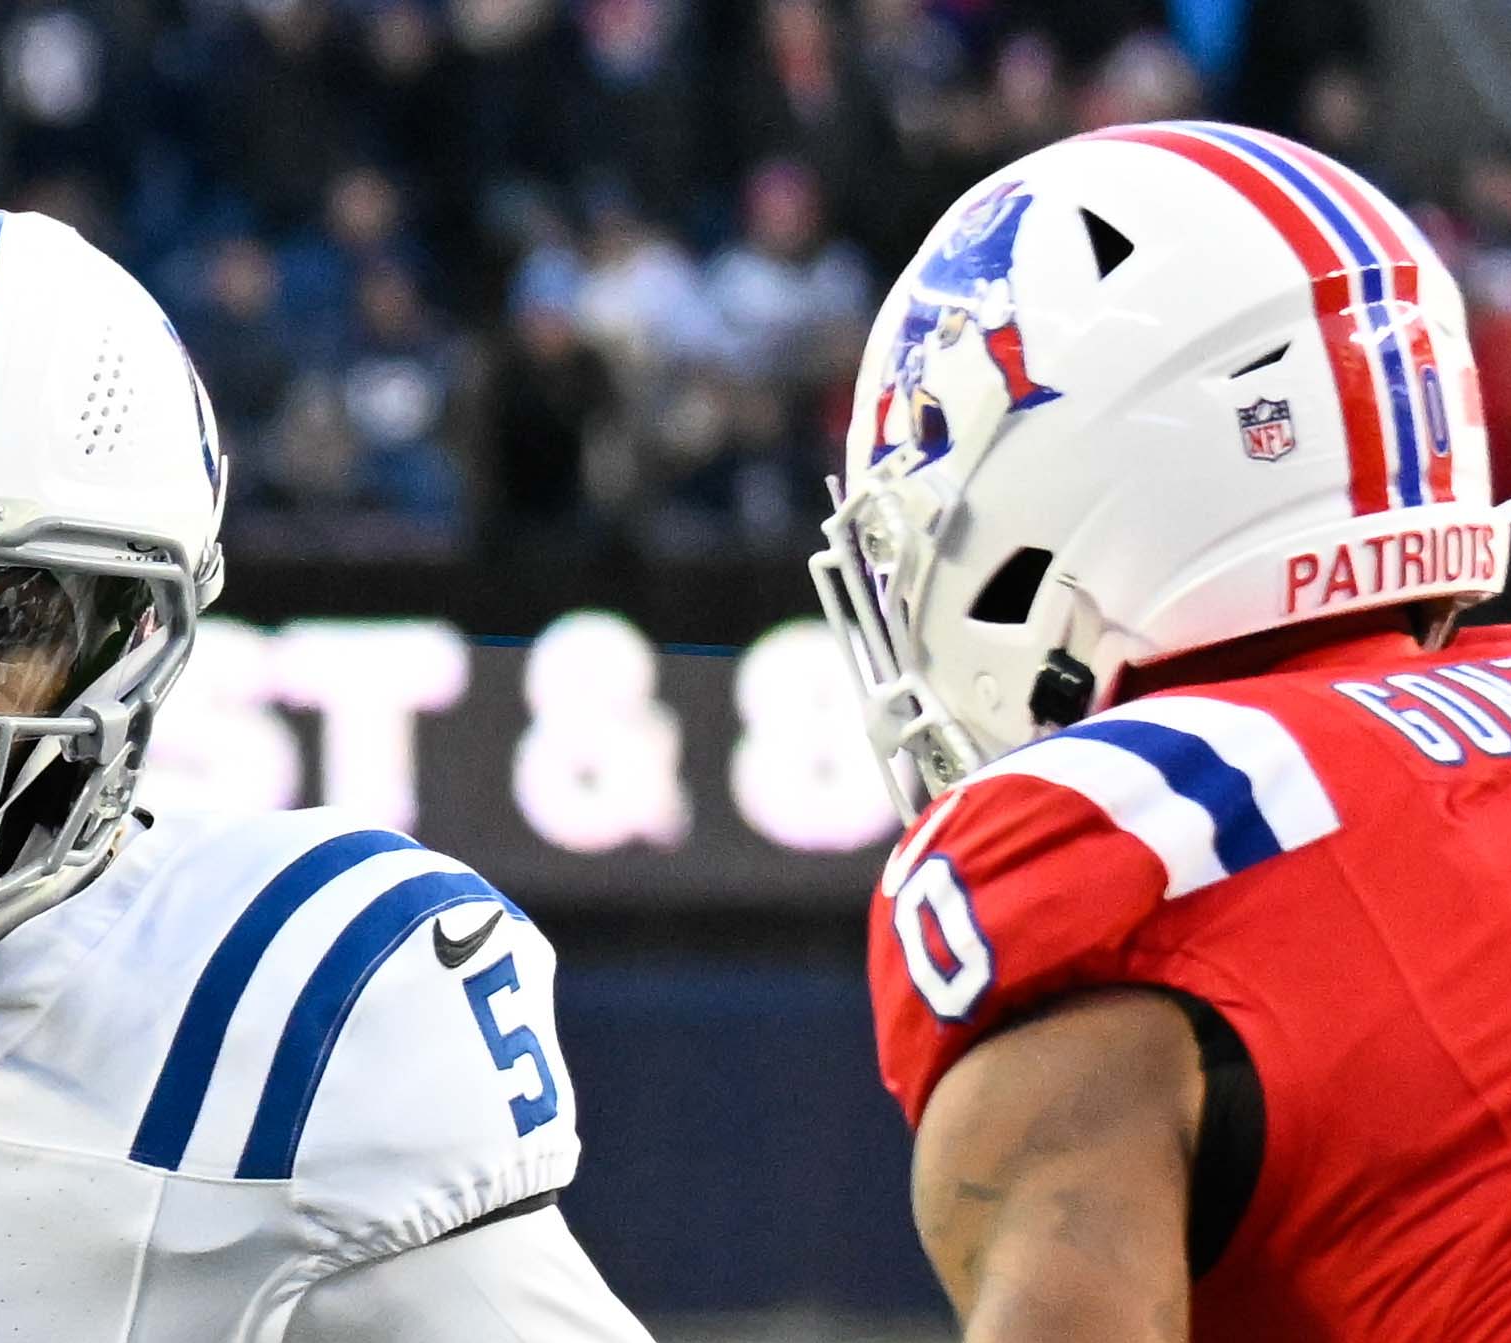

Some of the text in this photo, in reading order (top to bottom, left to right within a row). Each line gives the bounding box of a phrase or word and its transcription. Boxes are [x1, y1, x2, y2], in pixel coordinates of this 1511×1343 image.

[1285, 523, 1496, 614] PATRIOTS
[137, 612, 470, 836] ST
[511, 609, 693, 853] &
[892, 852, 997, 1023] 0
[463, 950, 558, 1138] 5
